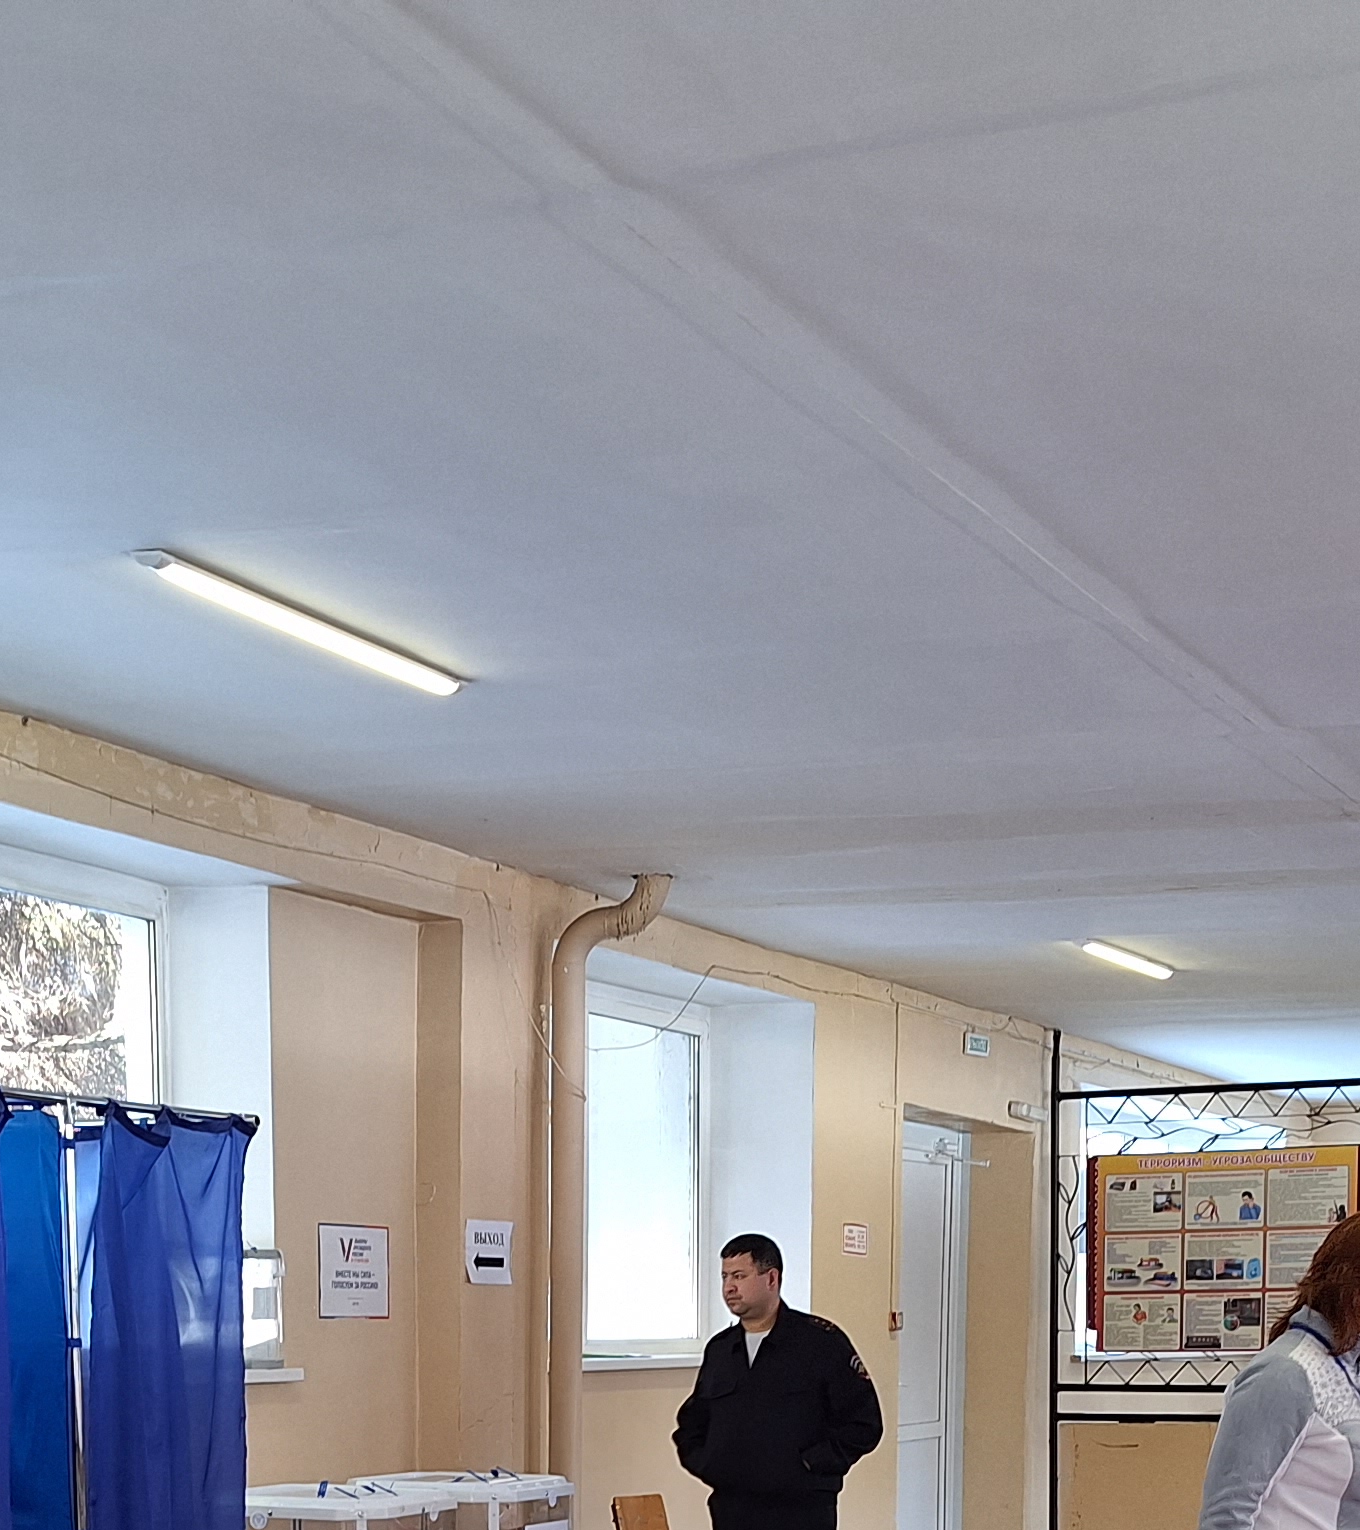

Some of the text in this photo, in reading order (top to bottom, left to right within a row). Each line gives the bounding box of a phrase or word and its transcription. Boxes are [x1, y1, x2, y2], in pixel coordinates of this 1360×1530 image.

[1138, 1157, 1202, 1169] ТЕРРОРИЗМ
[1211, 1155, 1252, 1166] УГРОЗА
[1255, 1152, 1316, 1165] ОБЩЕСТВУ
[474, 1232, 504, 1247] ВЫХОД
